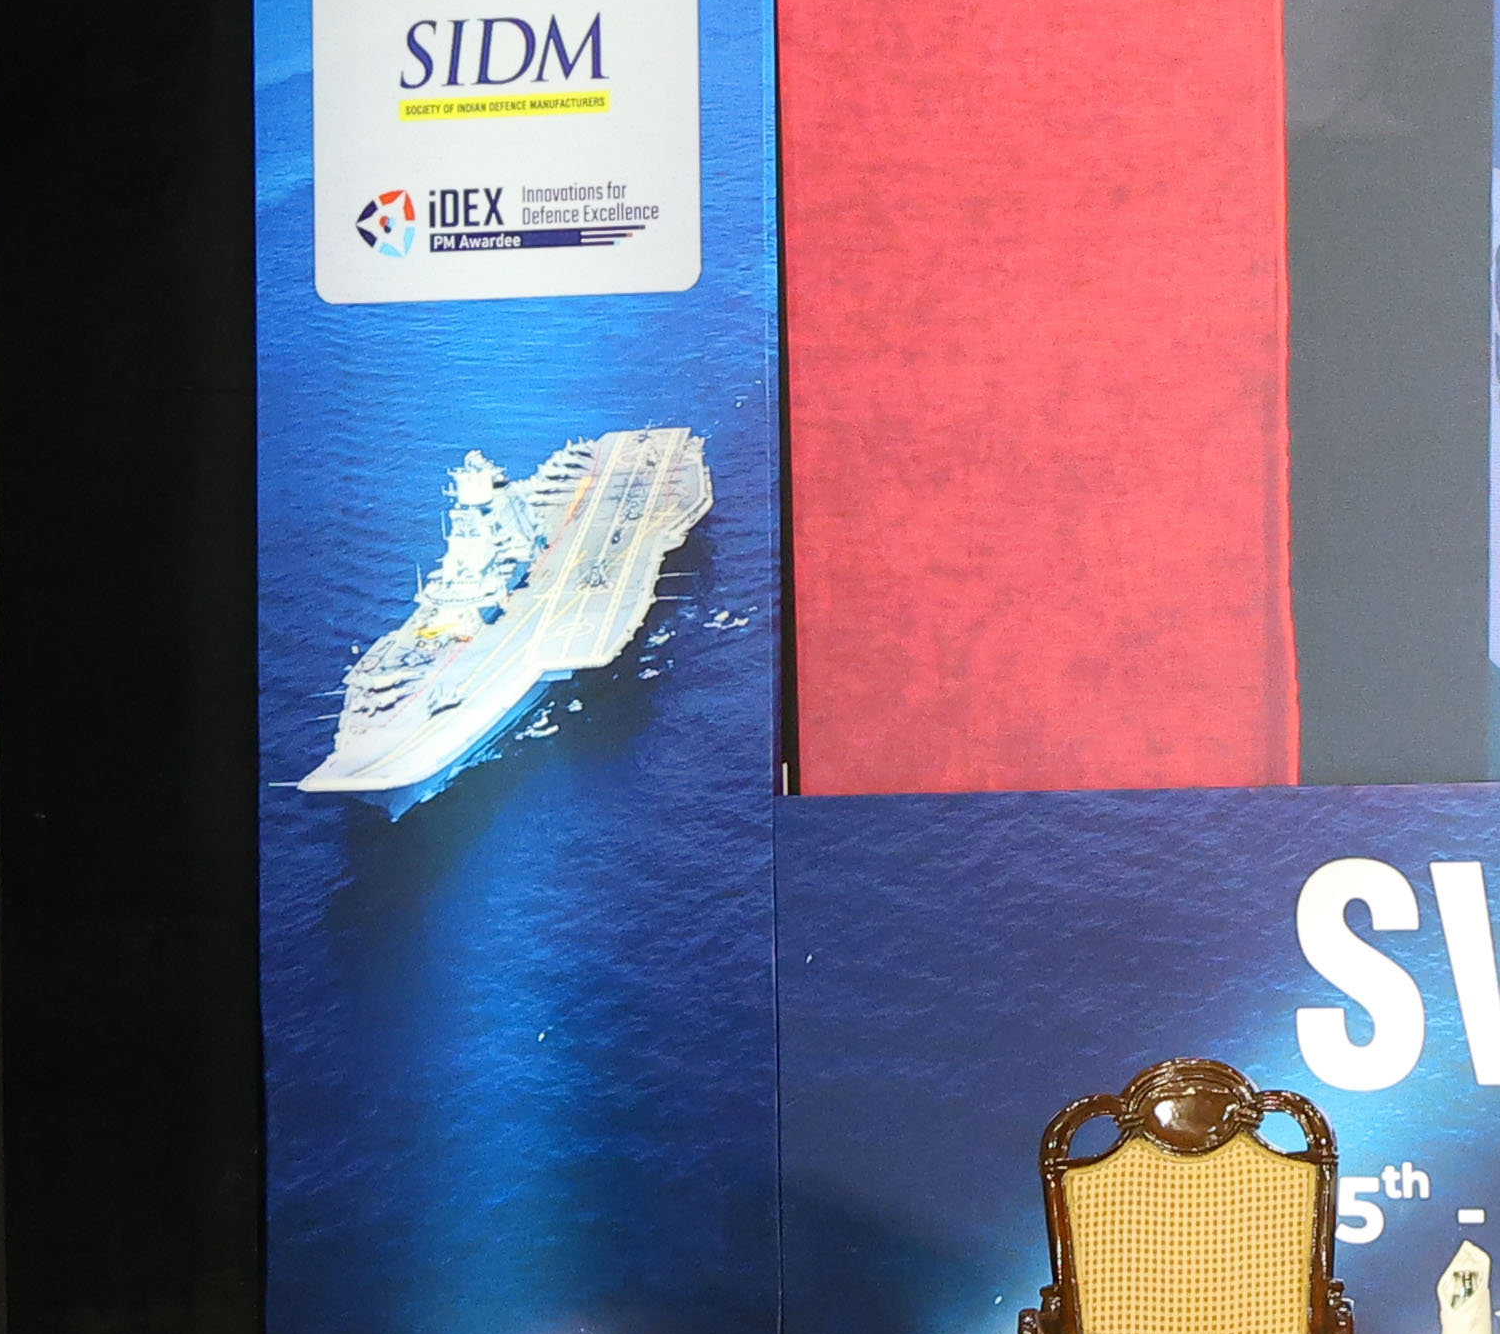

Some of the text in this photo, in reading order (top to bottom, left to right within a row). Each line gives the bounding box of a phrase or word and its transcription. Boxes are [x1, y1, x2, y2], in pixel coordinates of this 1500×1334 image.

[399, 11, 610, 89] SIDM
[405, 96, 605, 115] SOCIETY OF INDIAN DEFENCE MANUFACTURERS
[522, 181, 627, 204] Innovations for
[428, 186, 505, 229] iDEX
[522, 204, 659, 226] Defence Excellence
[433, 233, 521, 250] PM Awardee
[1335, 1162, 1431, 1245] 5th
